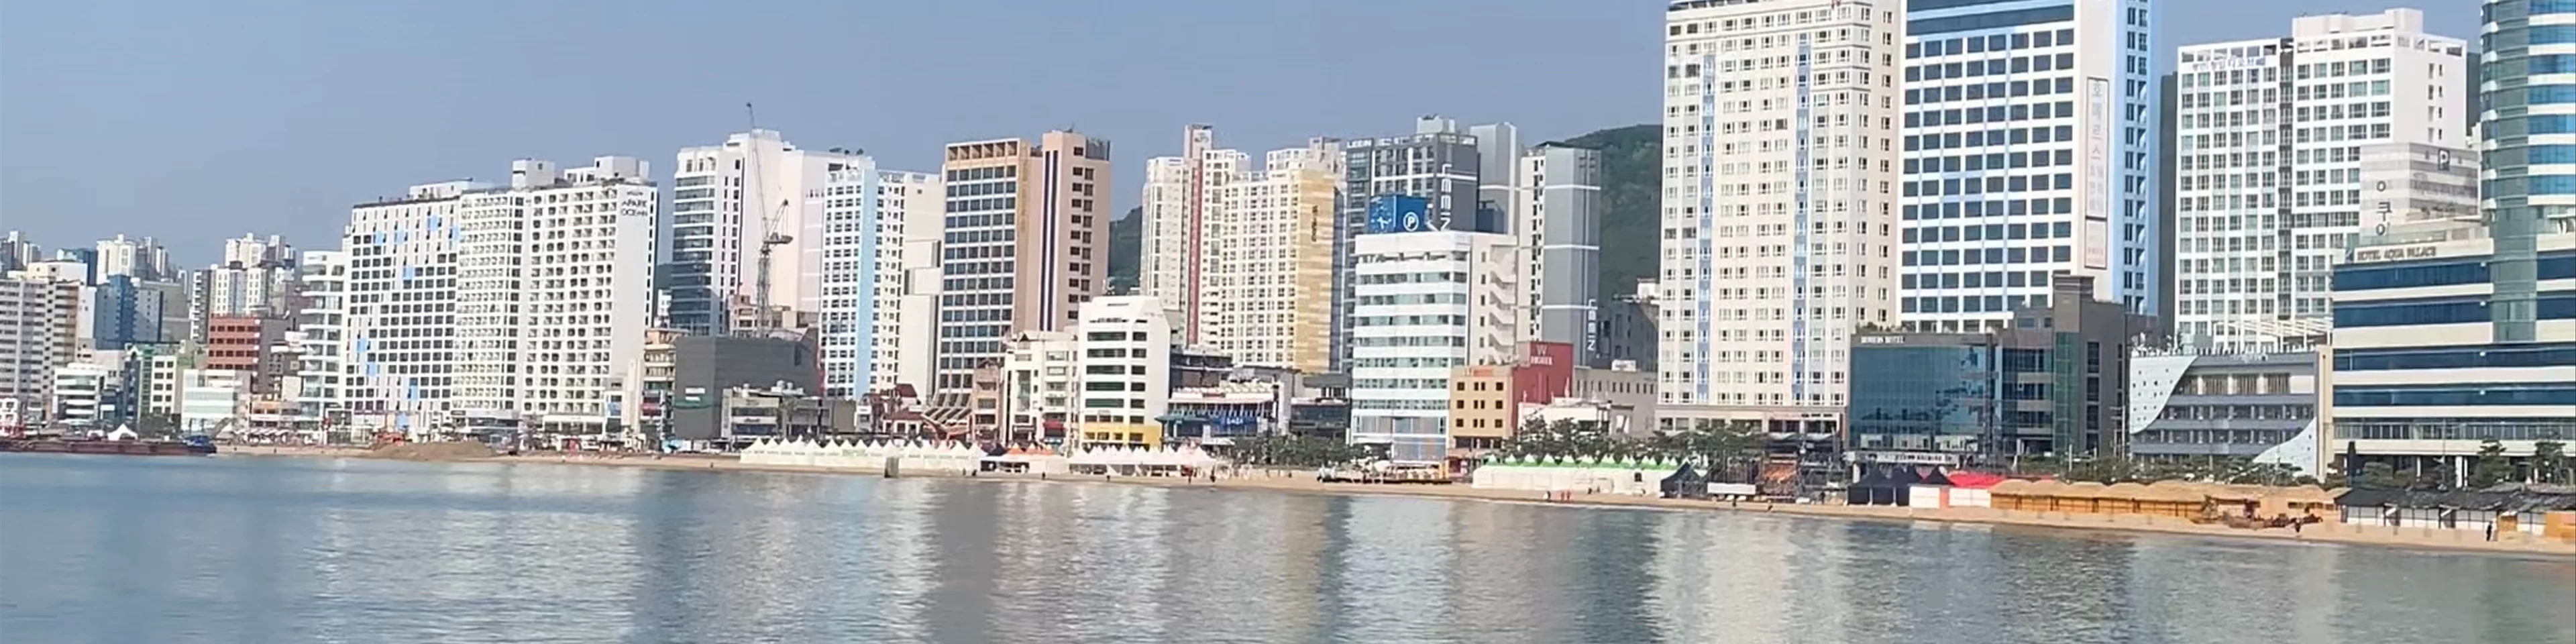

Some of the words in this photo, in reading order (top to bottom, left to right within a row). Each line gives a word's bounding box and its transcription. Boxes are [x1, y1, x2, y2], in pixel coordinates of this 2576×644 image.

[2440, 150, 2449, 169] P
[2357, 250, 2381, 261] HOTEL
[2383, 248, 2404, 260] AQUA
[2406, 246, 2436, 258] PALACE
